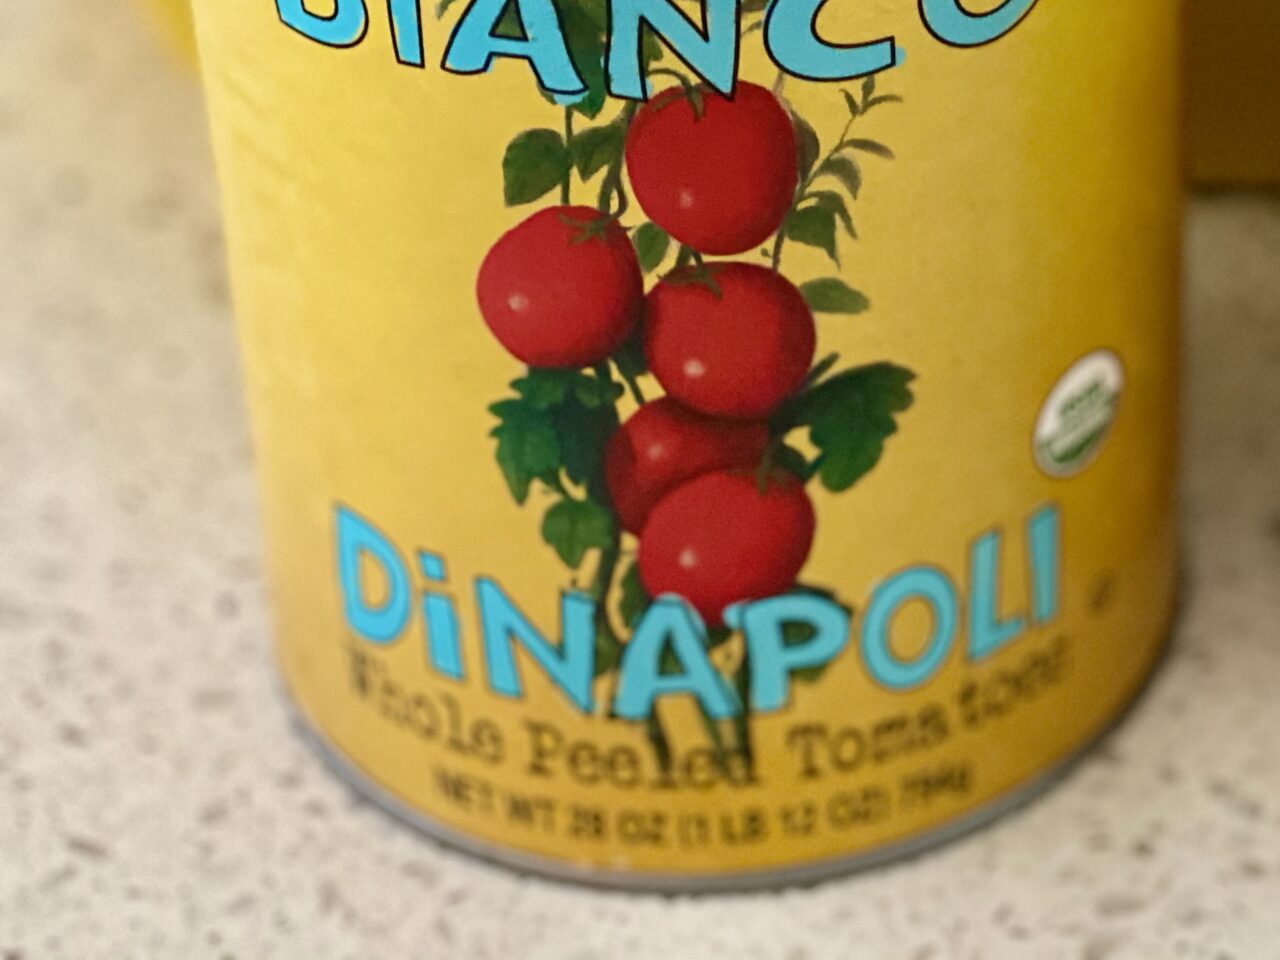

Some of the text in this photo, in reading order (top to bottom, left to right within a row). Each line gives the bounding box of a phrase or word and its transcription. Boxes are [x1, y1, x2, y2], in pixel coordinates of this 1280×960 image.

[333, 502, 1062, 719] DiNAPOLI
[349, 643, 504, 766] Whole
[522, 718, 759, 789] Peeled
